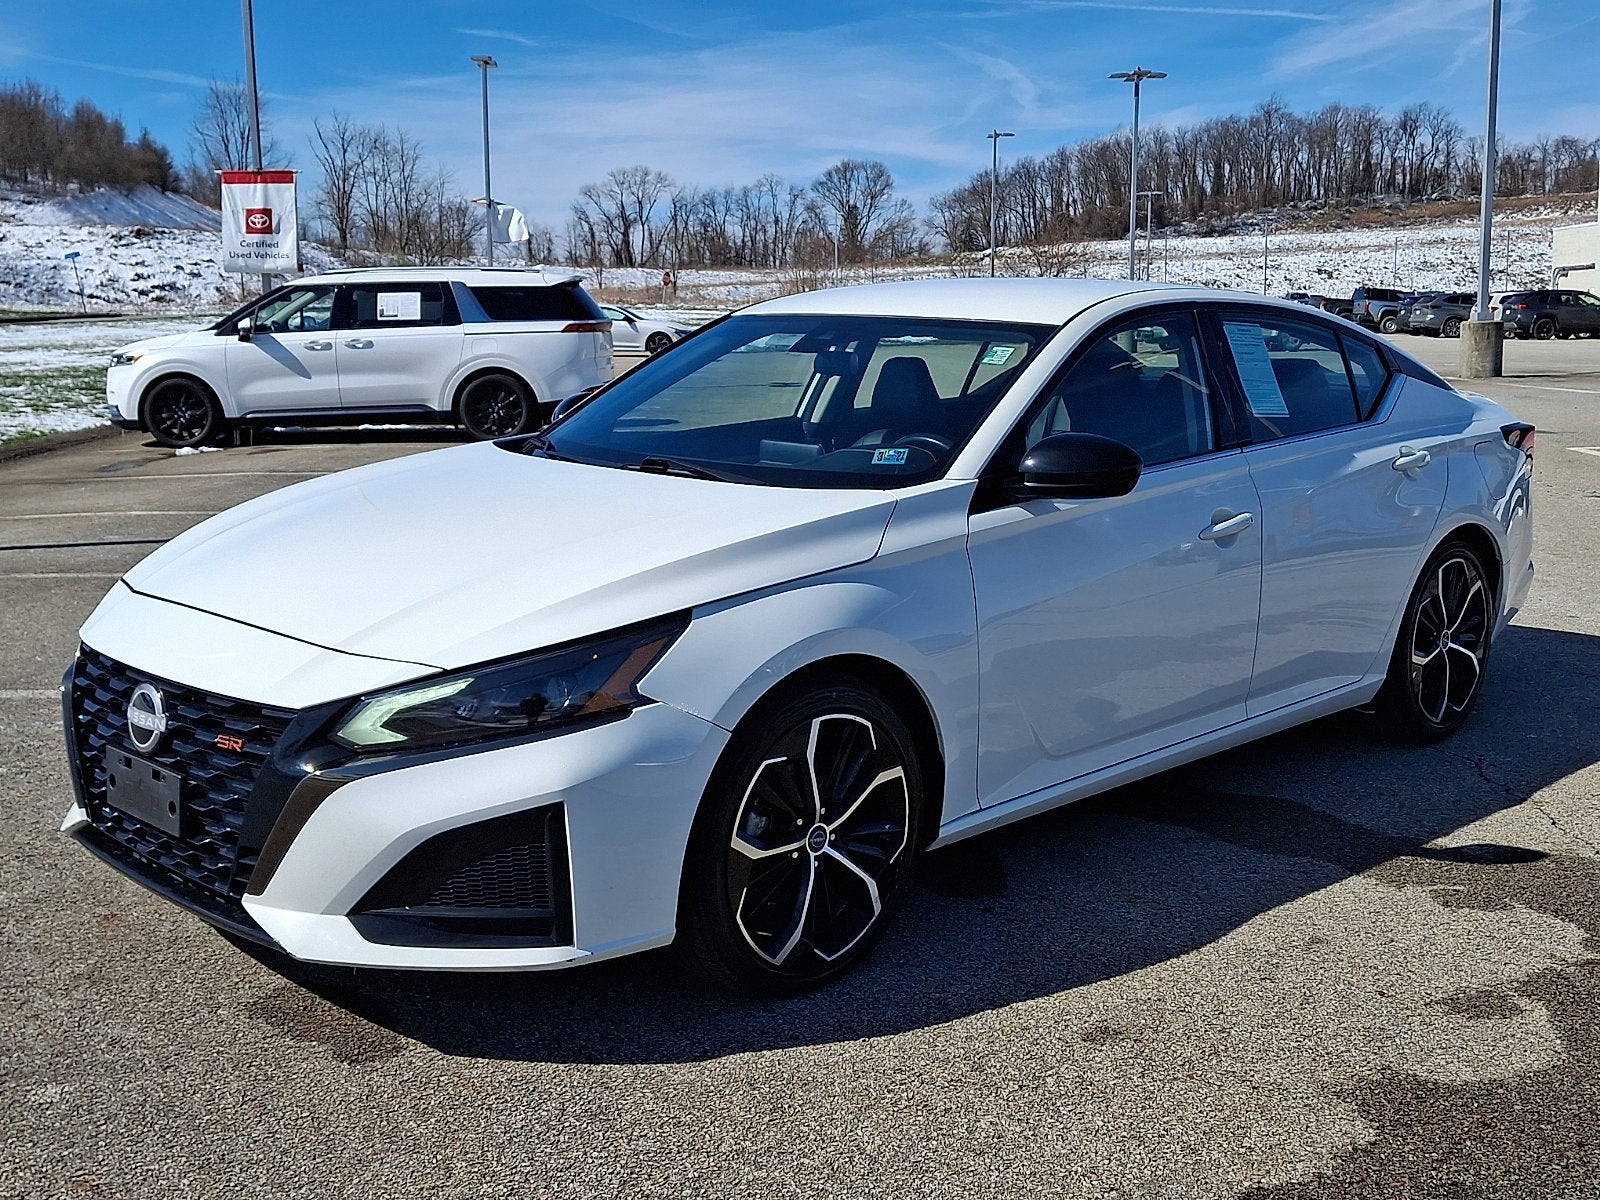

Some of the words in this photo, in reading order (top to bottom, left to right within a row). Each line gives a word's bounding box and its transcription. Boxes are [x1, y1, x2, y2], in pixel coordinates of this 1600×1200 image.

[239, 239, 279, 249] Certified
[229, 251, 252, 259] Used
[253, 251, 290, 259] Vehicles
[128, 705, 165, 731] SSAN
[216, 734, 243, 753] SR
